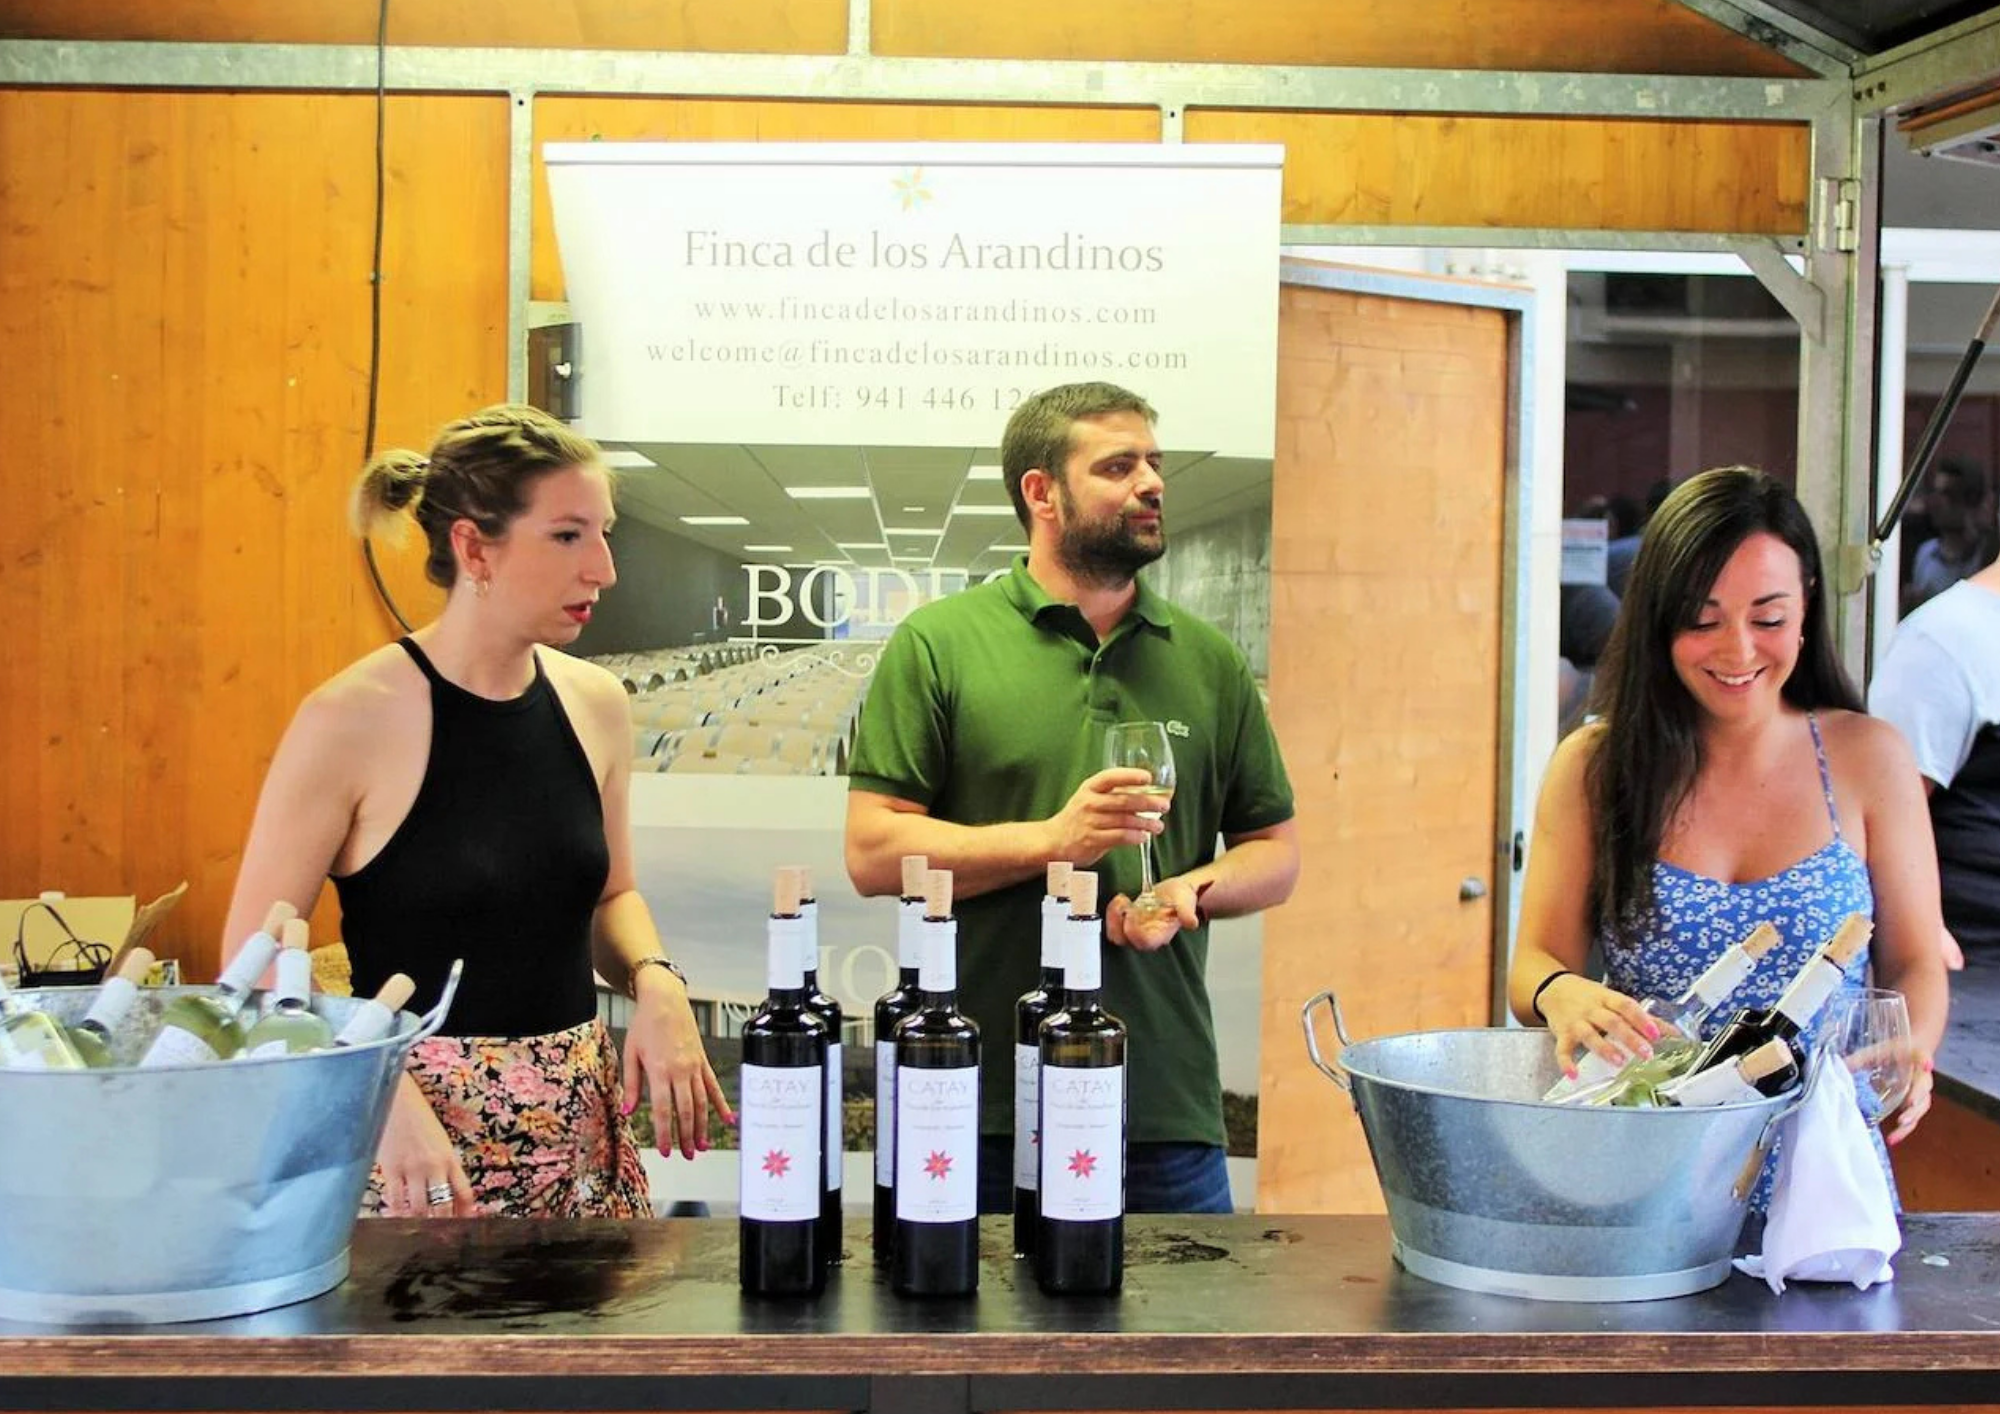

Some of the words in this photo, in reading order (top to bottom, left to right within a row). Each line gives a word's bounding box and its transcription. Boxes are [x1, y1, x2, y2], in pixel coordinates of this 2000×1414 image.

[685, 229, 795, 268] Finca
[806, 228, 856, 269] de
[870, 229, 929, 270] los
[939, 231, 1164, 273] Arandinos
[694, 296, 1156, 324] www.fincadelosarandinos.com
[647, 337, 1188, 370] welcome@fincadelosarandinos.com
[771, 384, 841, 409] Telf:
[856, 385, 905, 410] 941
[921, 387, 975, 411] 446
[747, 1077, 810, 1094] CATAY
[907, 1079, 967, 1097] CATAY
[1052, 1079, 1113, 1095] CATAY
